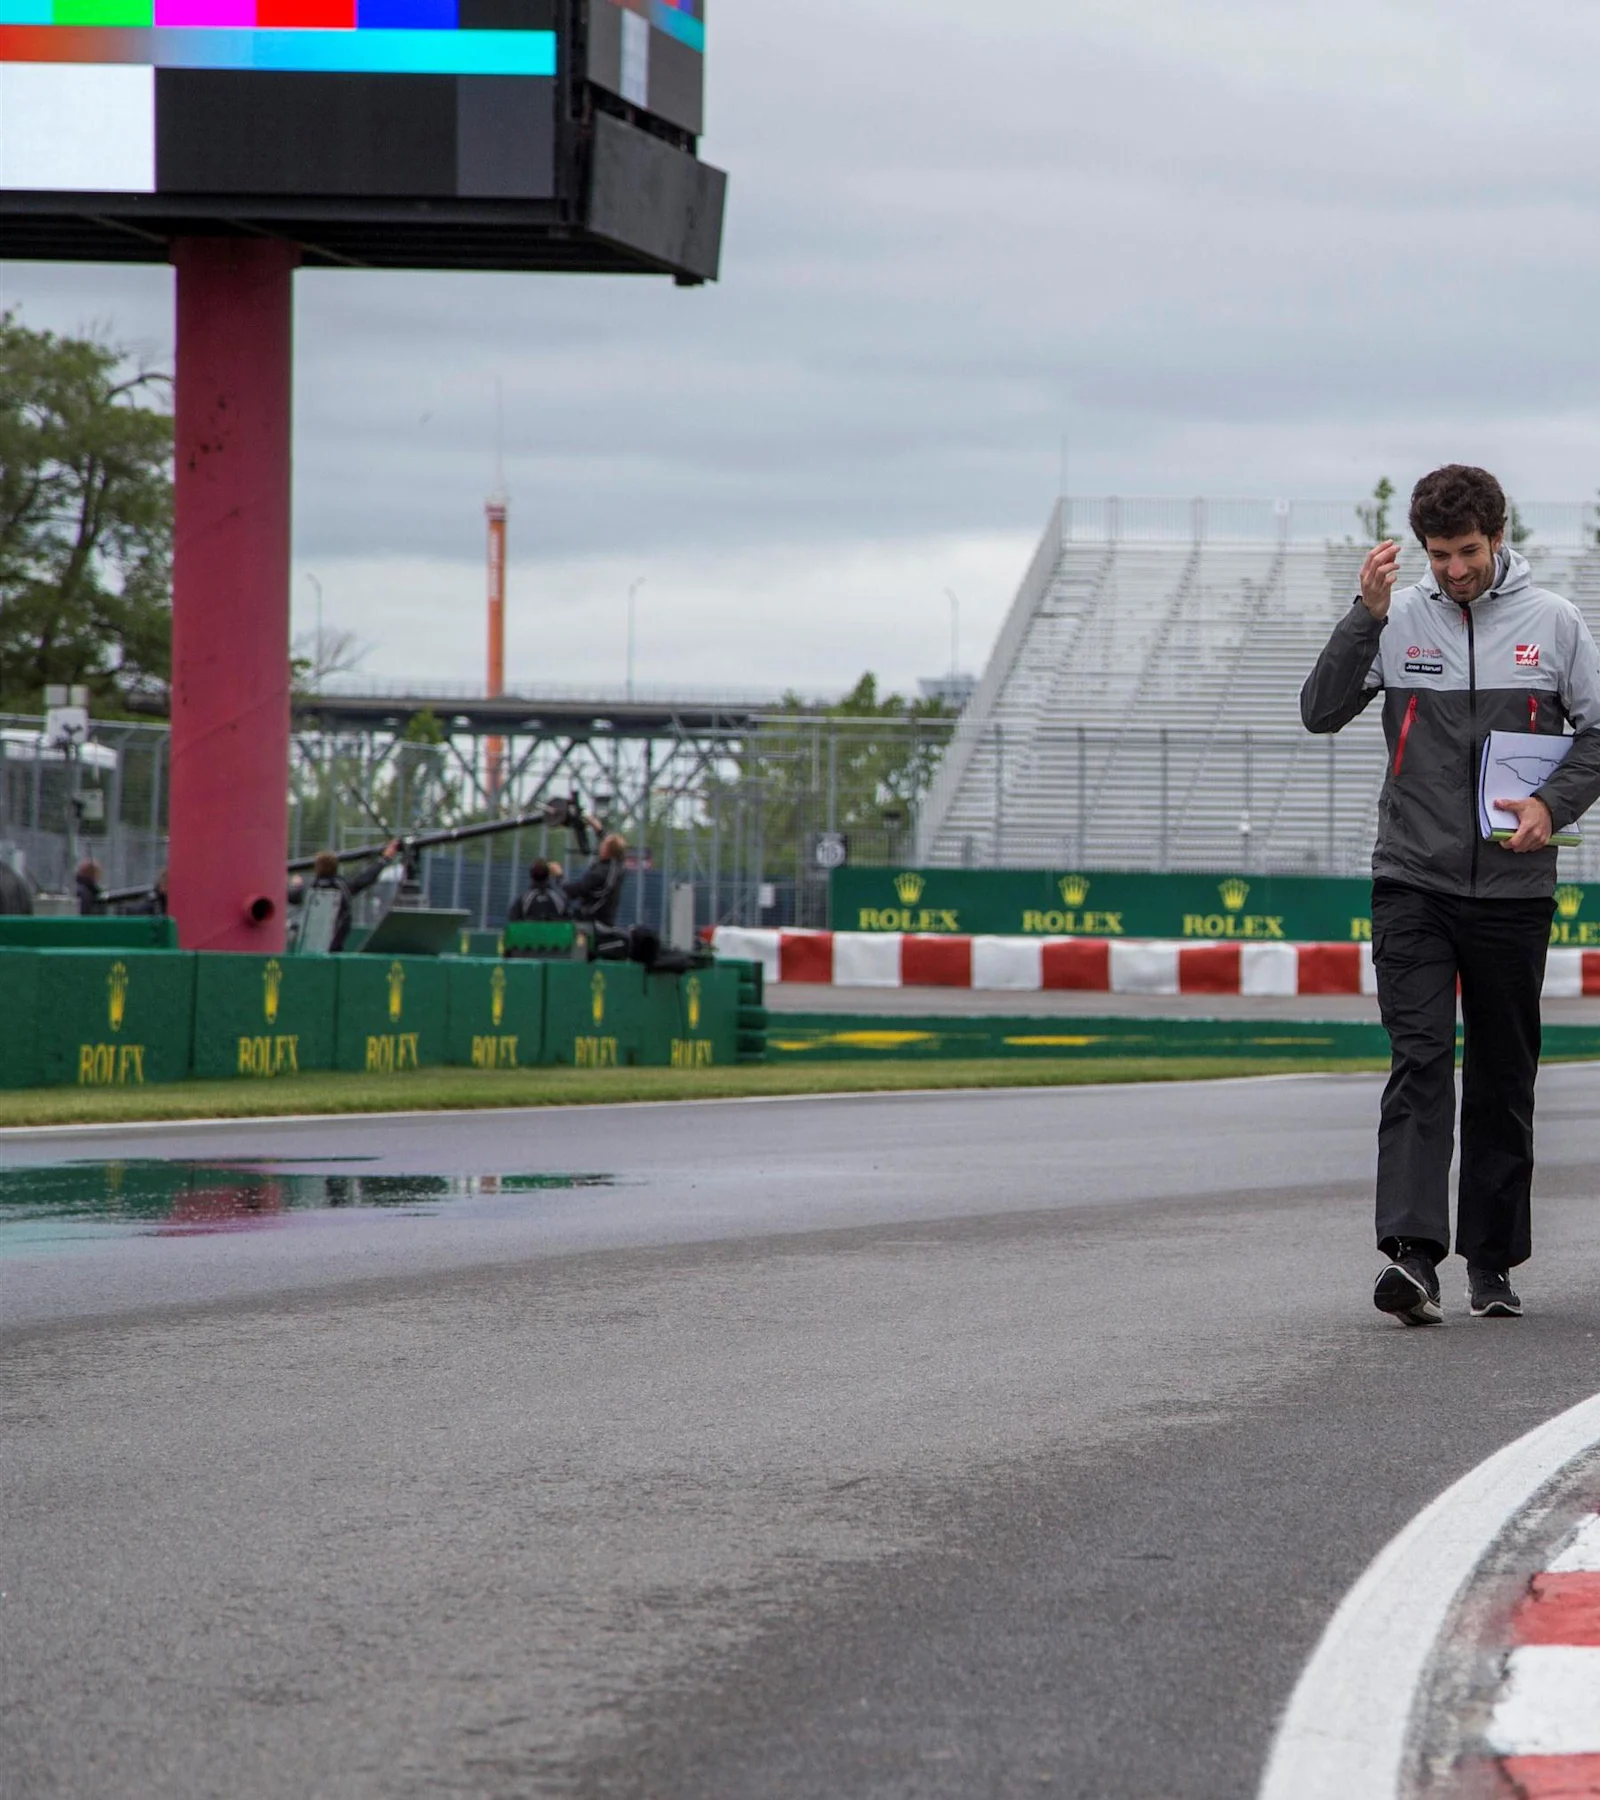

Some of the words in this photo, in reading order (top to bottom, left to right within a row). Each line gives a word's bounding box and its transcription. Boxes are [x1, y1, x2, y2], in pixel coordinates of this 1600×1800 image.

[858, 908, 960, 931] ROLEX
[1021, 910, 1124, 934] ROLEX
[1183, 914, 1285, 938] ROLEX
[79, 1043, 145, 1084] ROLEX
[237, 1034, 299, 1077] ROLEX
[366, 1032, 419, 1073] ROLEX
[472, 1035, 518, 1069] ROLEX
